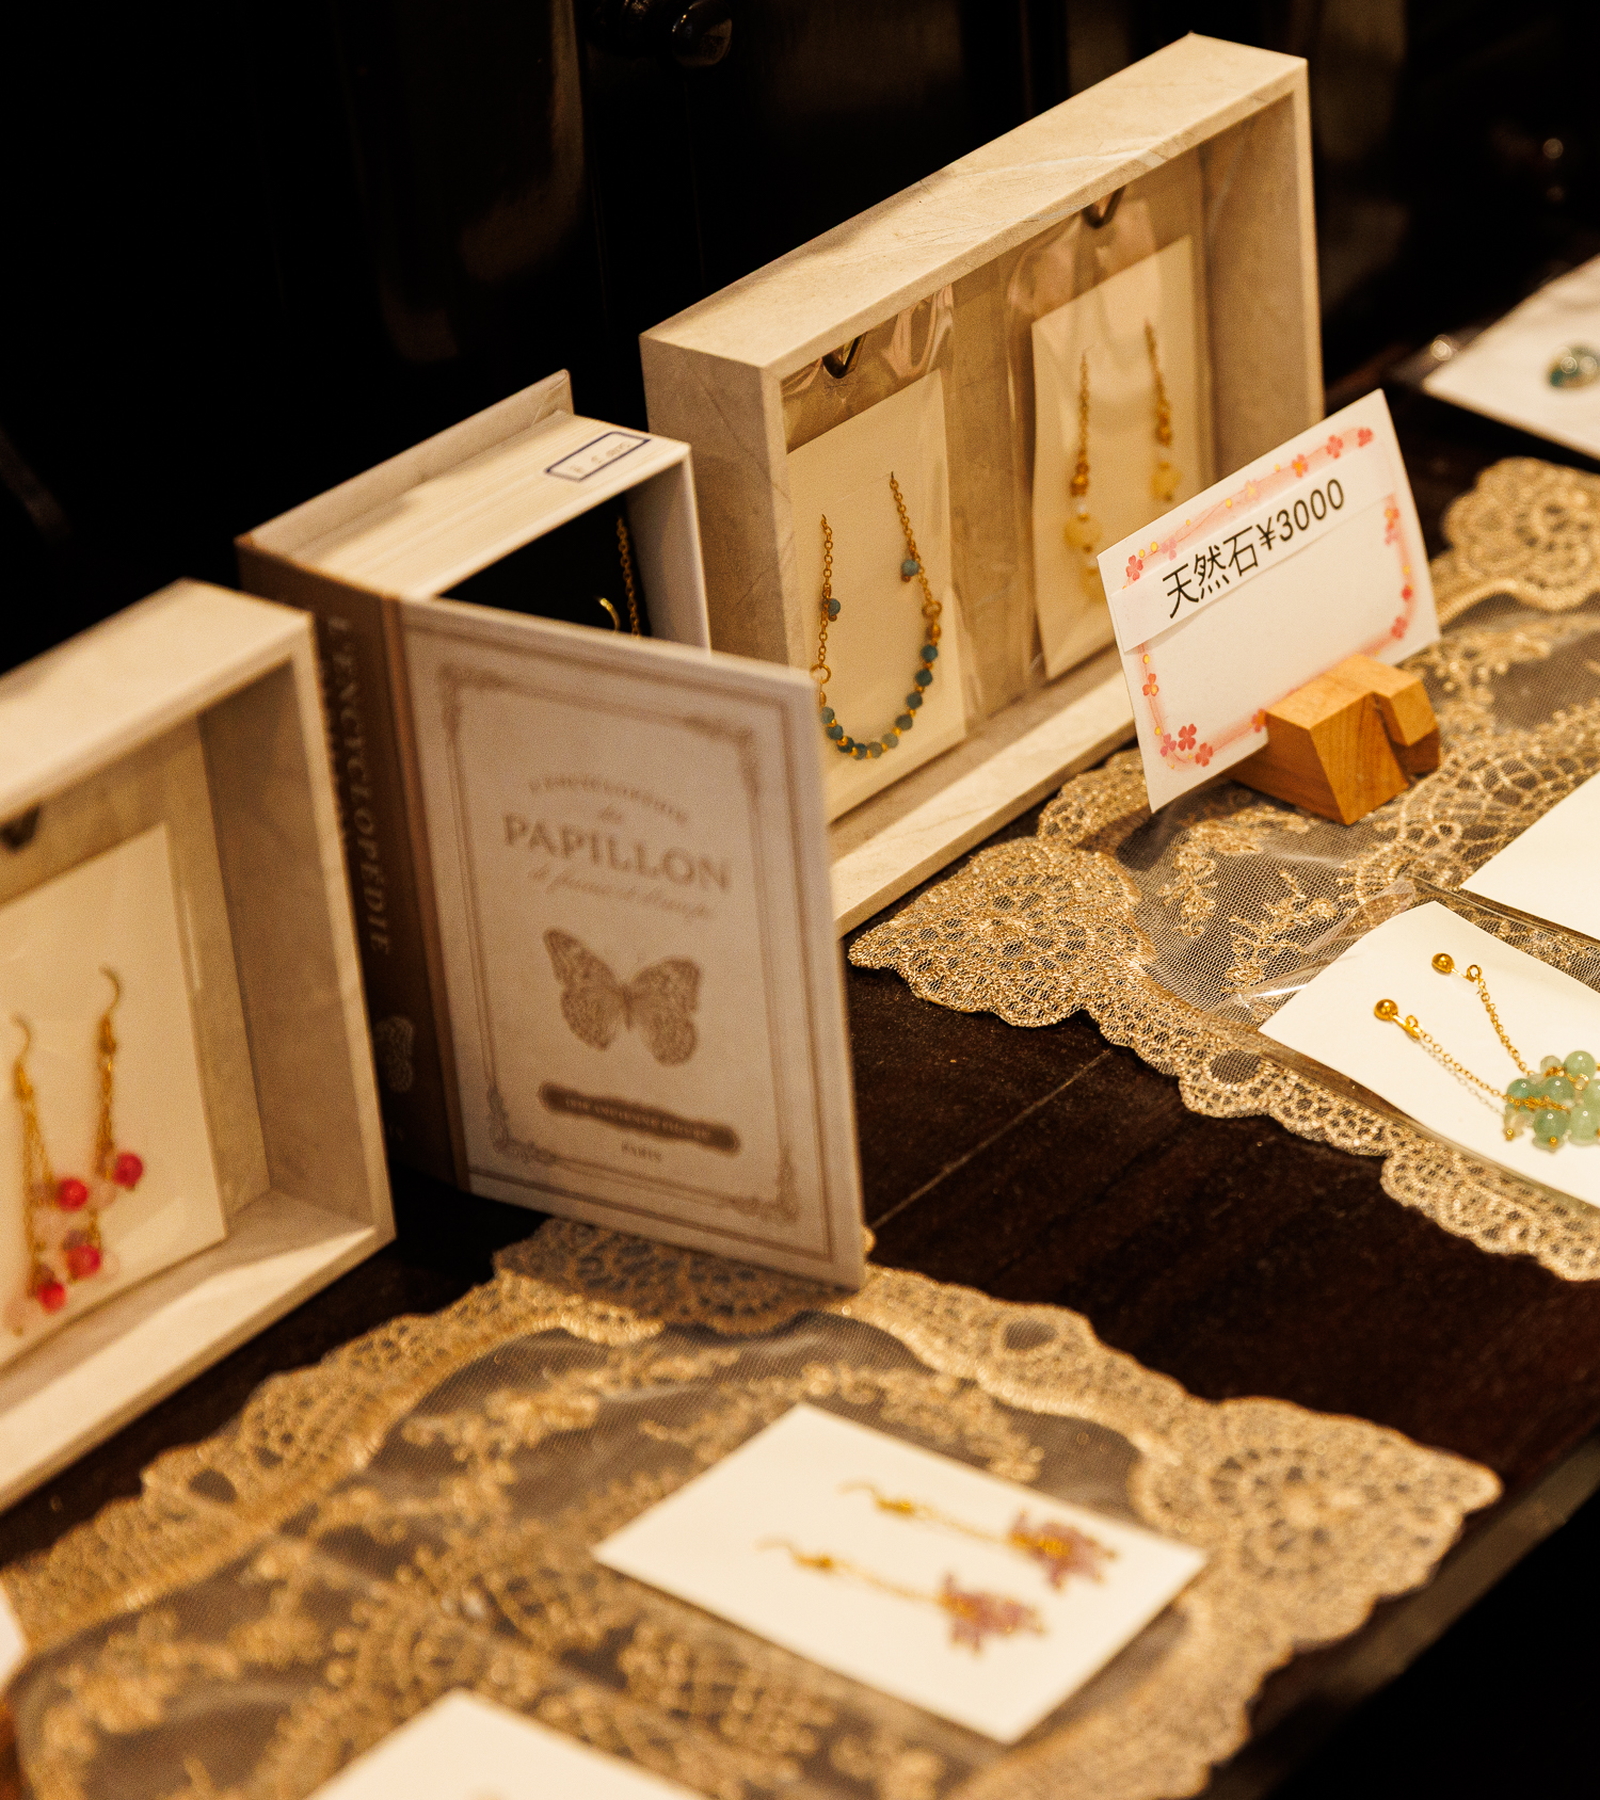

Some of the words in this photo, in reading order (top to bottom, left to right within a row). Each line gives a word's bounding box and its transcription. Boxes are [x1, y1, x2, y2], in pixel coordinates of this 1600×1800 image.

[1161, 477, 1345, 619] 天然石¥3000
[504, 813, 731, 892] PAPILLON
